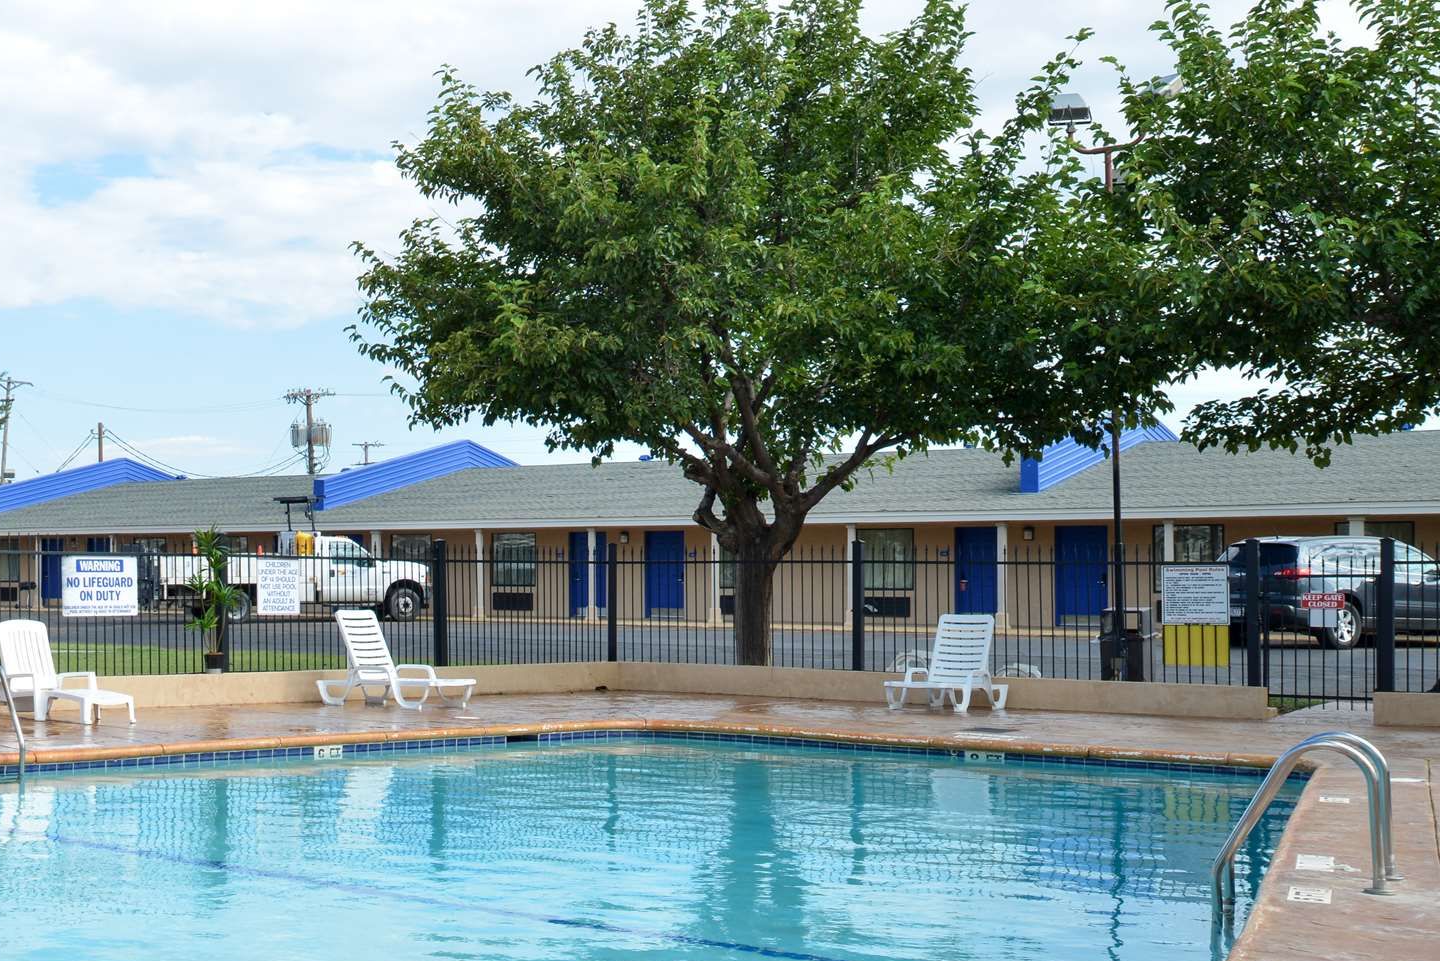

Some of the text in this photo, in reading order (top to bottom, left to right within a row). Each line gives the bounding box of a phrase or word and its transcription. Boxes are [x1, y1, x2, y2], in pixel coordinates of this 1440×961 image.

[79, 560, 121, 572] WARNING
[66, 576, 133, 588] NO LIFEGUARD
[79, 590, 121, 601] ON DUTY
